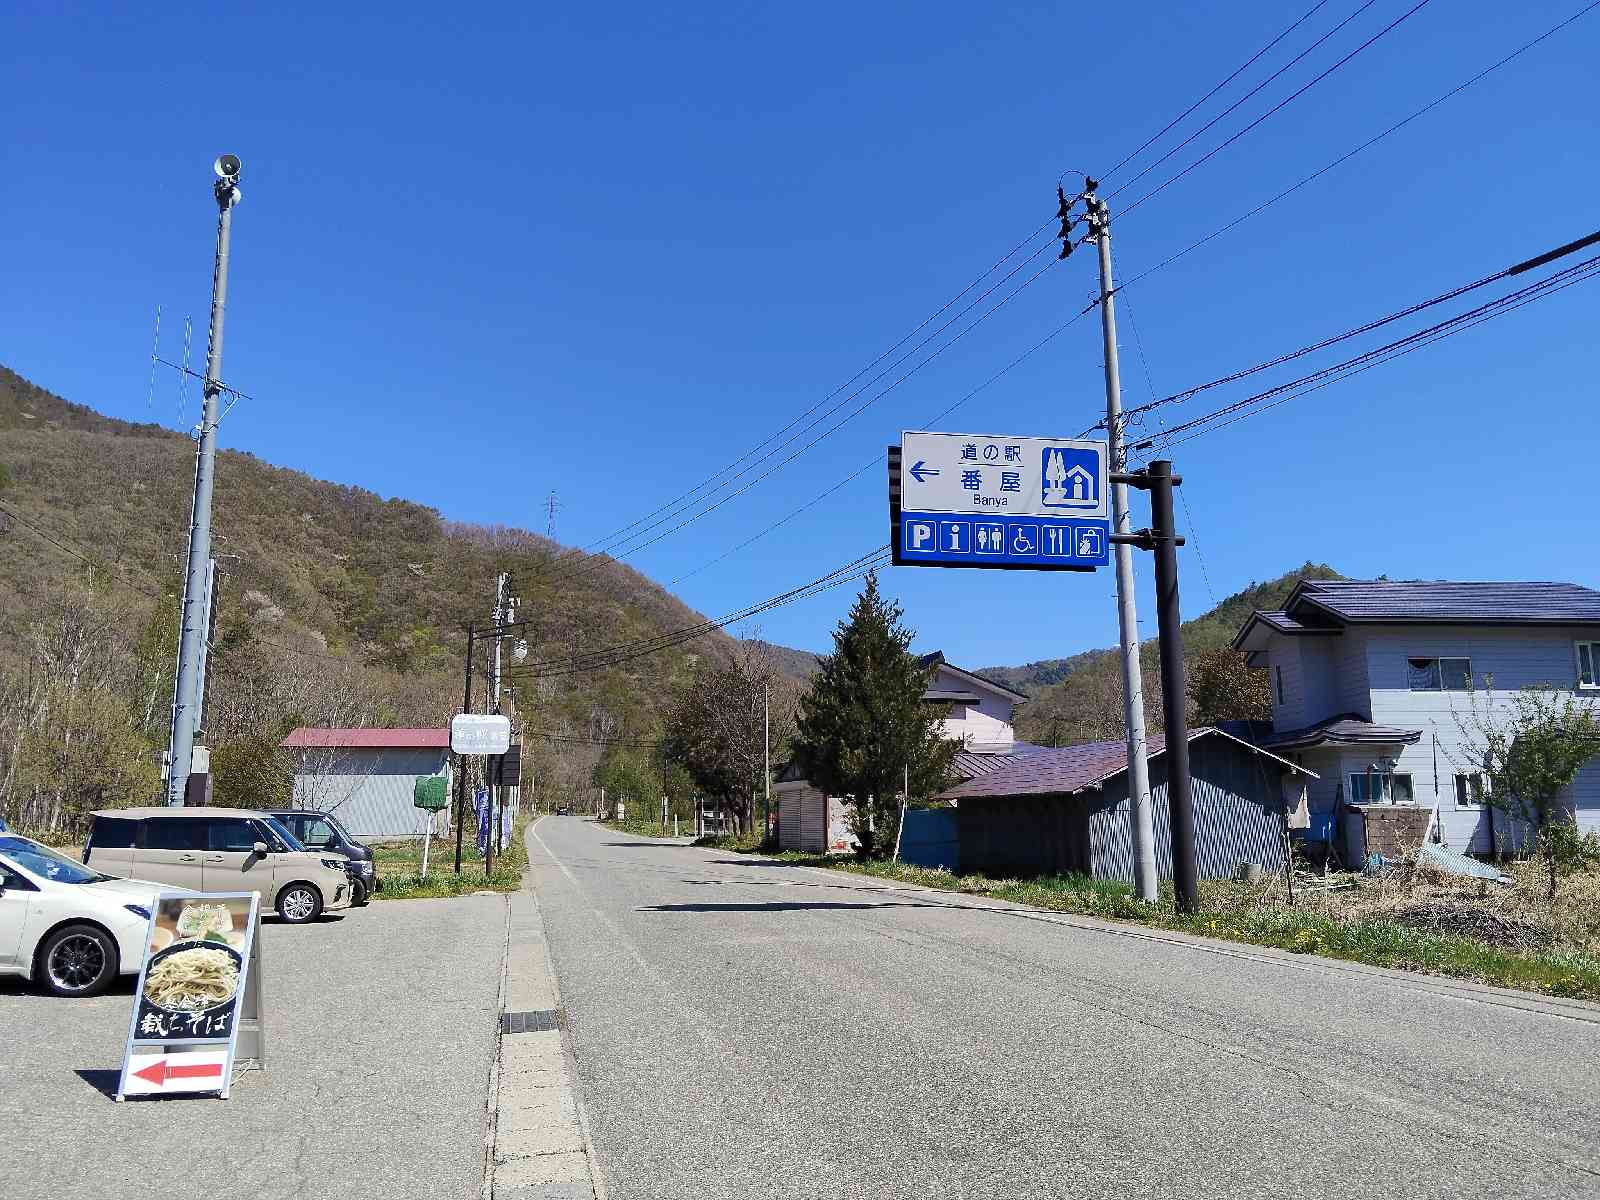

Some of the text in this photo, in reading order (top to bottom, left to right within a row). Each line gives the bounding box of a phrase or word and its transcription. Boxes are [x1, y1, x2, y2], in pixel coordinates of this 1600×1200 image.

[960, 443, 1021, 463] 道の駅
[960, 469, 1021, 493] 番屋
[973, 494, 1008, 508] Banya
